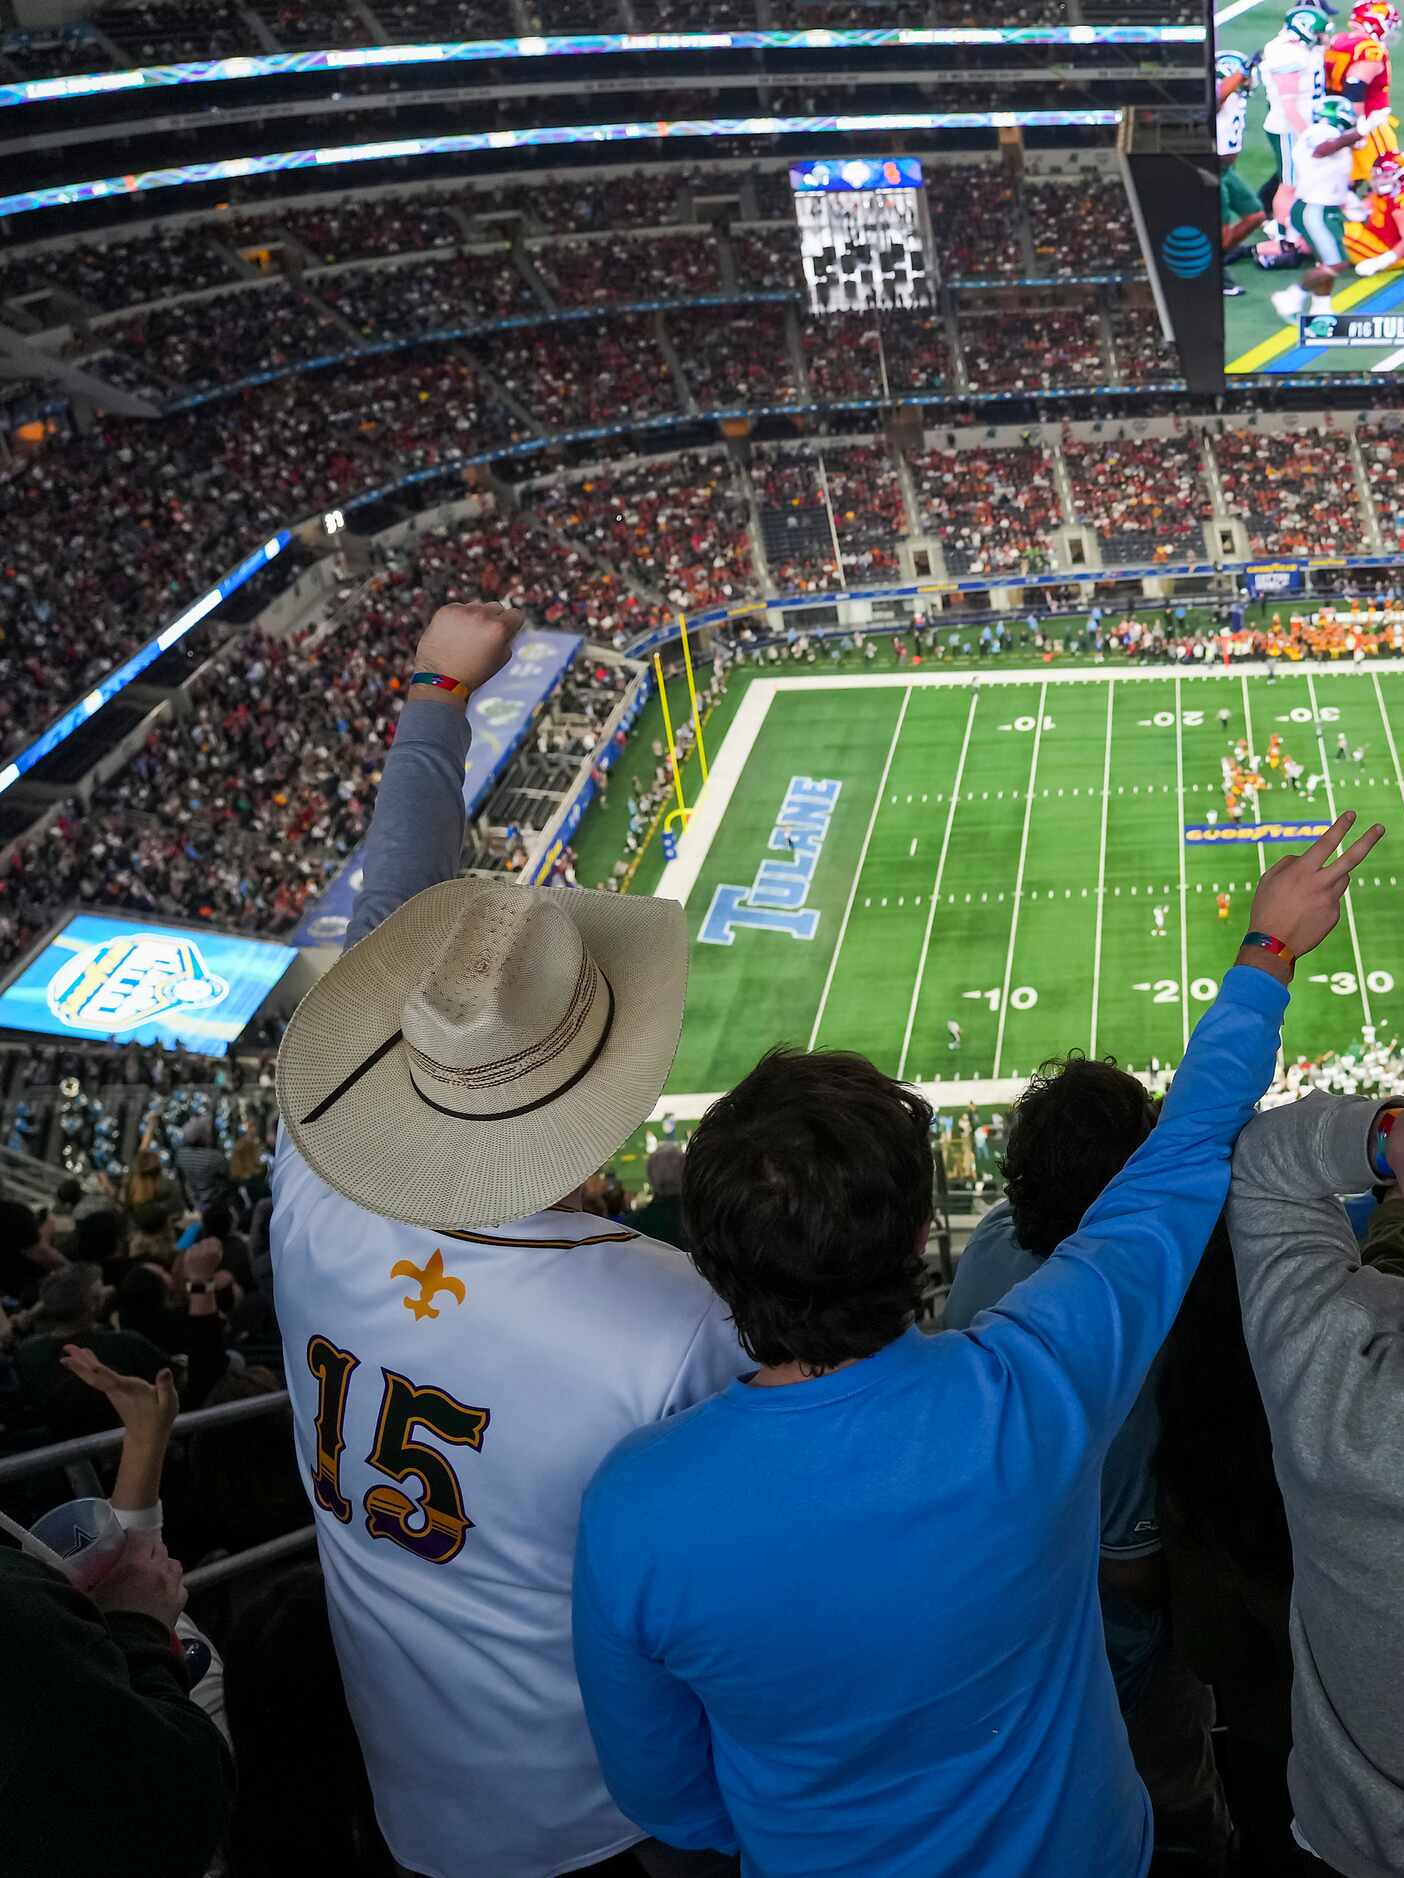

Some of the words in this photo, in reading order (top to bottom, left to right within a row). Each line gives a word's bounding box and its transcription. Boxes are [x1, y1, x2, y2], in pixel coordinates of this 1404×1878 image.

[1152, 977, 1219, 1003] 20
[1329, 970, 1395, 997] 30
[983, 986, 1039, 1012] 10
[306, 1333, 491, 1566] 15
